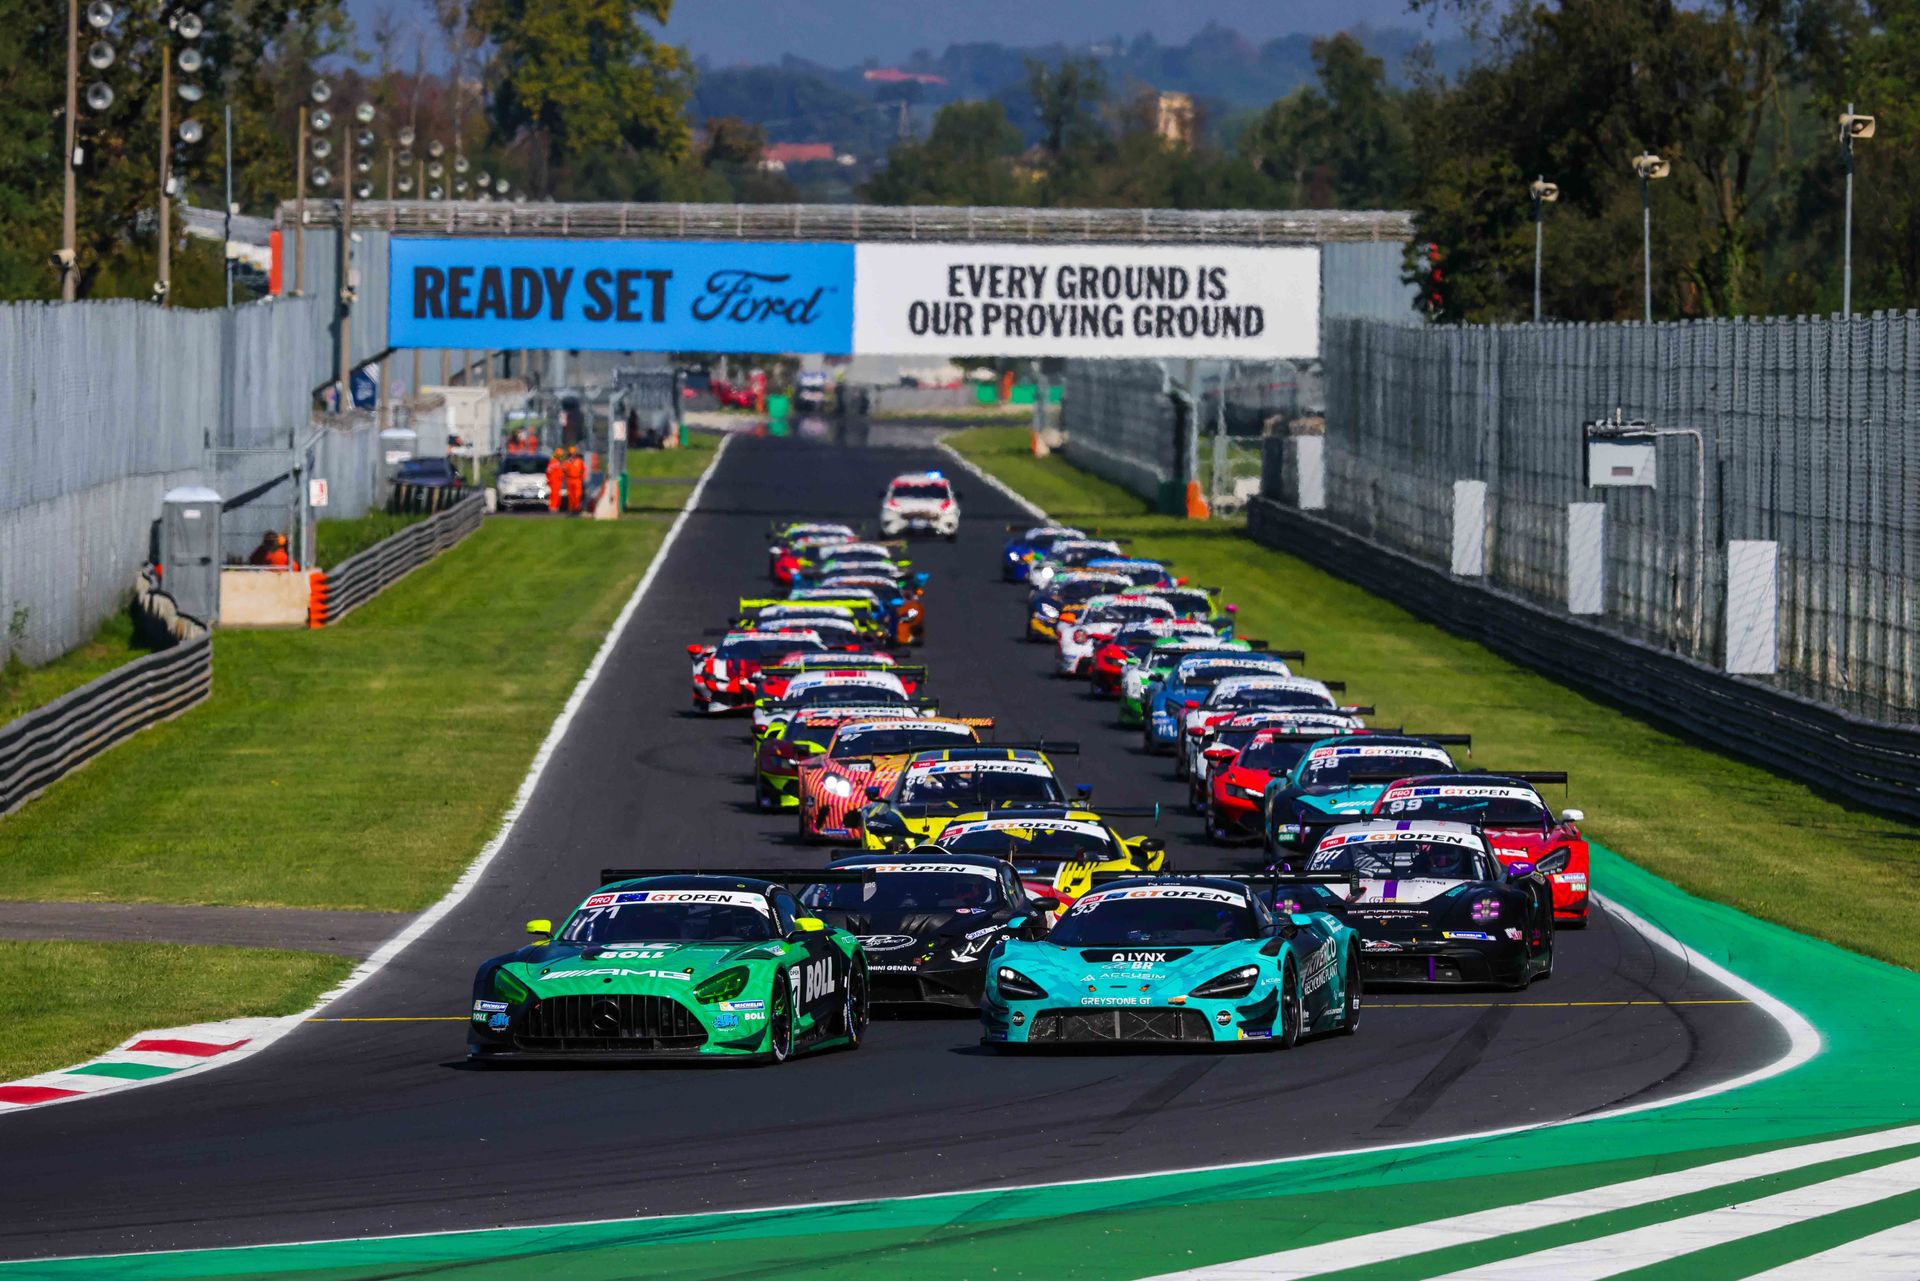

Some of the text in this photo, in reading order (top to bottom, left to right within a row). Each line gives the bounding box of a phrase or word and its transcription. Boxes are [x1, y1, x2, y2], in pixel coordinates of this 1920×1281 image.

[948, 265, 1228, 300] EVERY GROUND IS
[413, 266, 673, 323] READY SET
[691, 269, 824, 325] Ford
[909, 301, 1265, 339] OUR PROVING GROUND
[1315, 749, 1333, 757] PRO
[1364, 749, 1423, 757] GTOPEN
[1310, 758, 1339, 771] 28
[907, 776, 927, 786] 66
[1392, 789, 1411, 798] PRO
[1445, 789, 1510, 797] GTOPEN
[1390, 798, 1423, 813] 99
[991, 822, 1078, 831] GTOPEN
[944, 835, 962, 847] 17
[1370, 833, 1463, 843] GTOPEN
[1315, 849, 1345, 863] 911
[589, 896, 611, 906] PRO
[651, 893, 732, 903] GTOPEN
[1130, 890, 1232, 902] GTOPEN
[586, 906, 621, 922] 71
[1071, 902, 1101, 917] 33
[598, 951, 666, 959] BOLL
[1128, 953, 1166, 962] LYNX
[586, 968, 691, 981] AMG
[806, 957, 836, 1004] BOLL
[1081, 997, 1151, 1005] GREYSTONE GT
[744, 1012, 766, 1021] BOLL
